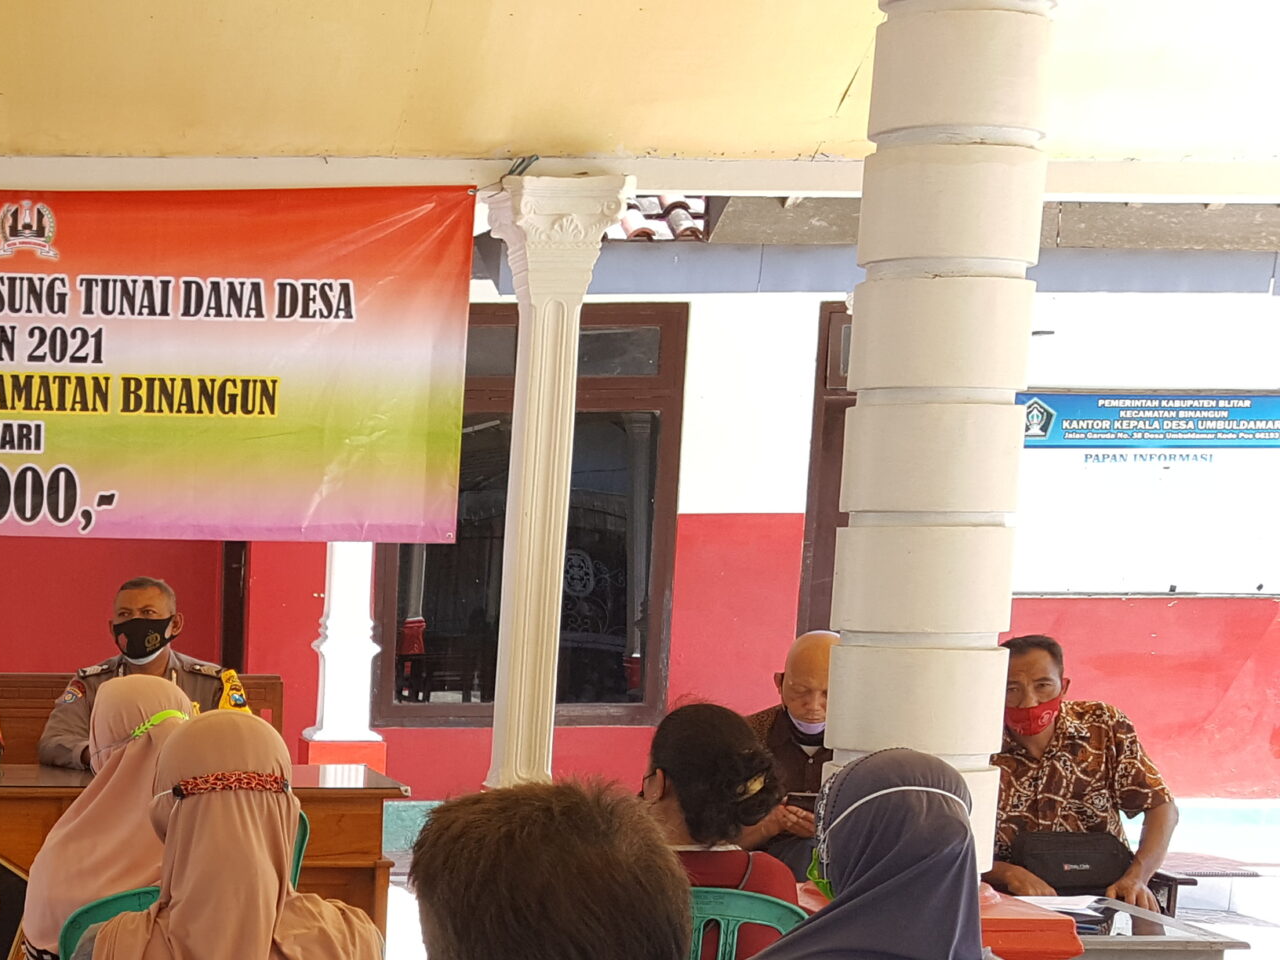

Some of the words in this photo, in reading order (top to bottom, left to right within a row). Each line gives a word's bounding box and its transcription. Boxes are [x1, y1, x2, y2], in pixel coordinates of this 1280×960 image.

[79, 278, 171, 317] TUNAI
[181, 280, 264, 318] DANA
[276, 282, 353, 319] DESA
[27, 326, 103, 364] 2021
[121, 377, 277, 415] BINANGUN
[1098, 399, 1159, 408] PEMERINTAH
[1161, 399, 1216, 408] KABUPATEN
[1218, 399, 1251, 408] BLITAR
[1120, 410, 1176, 418] KECAMATAN
[1178, 410, 1228, 418] BINANGUN
[1062, 420, 1110, 430] KANTOR
[1114, 420, 1160, 430] KEPALA
[1163, 420, 1195, 430] DESA
[1084, 453, 1128, 463] PAPAN
[1133, 453, 1213, 462] INFORMASI
